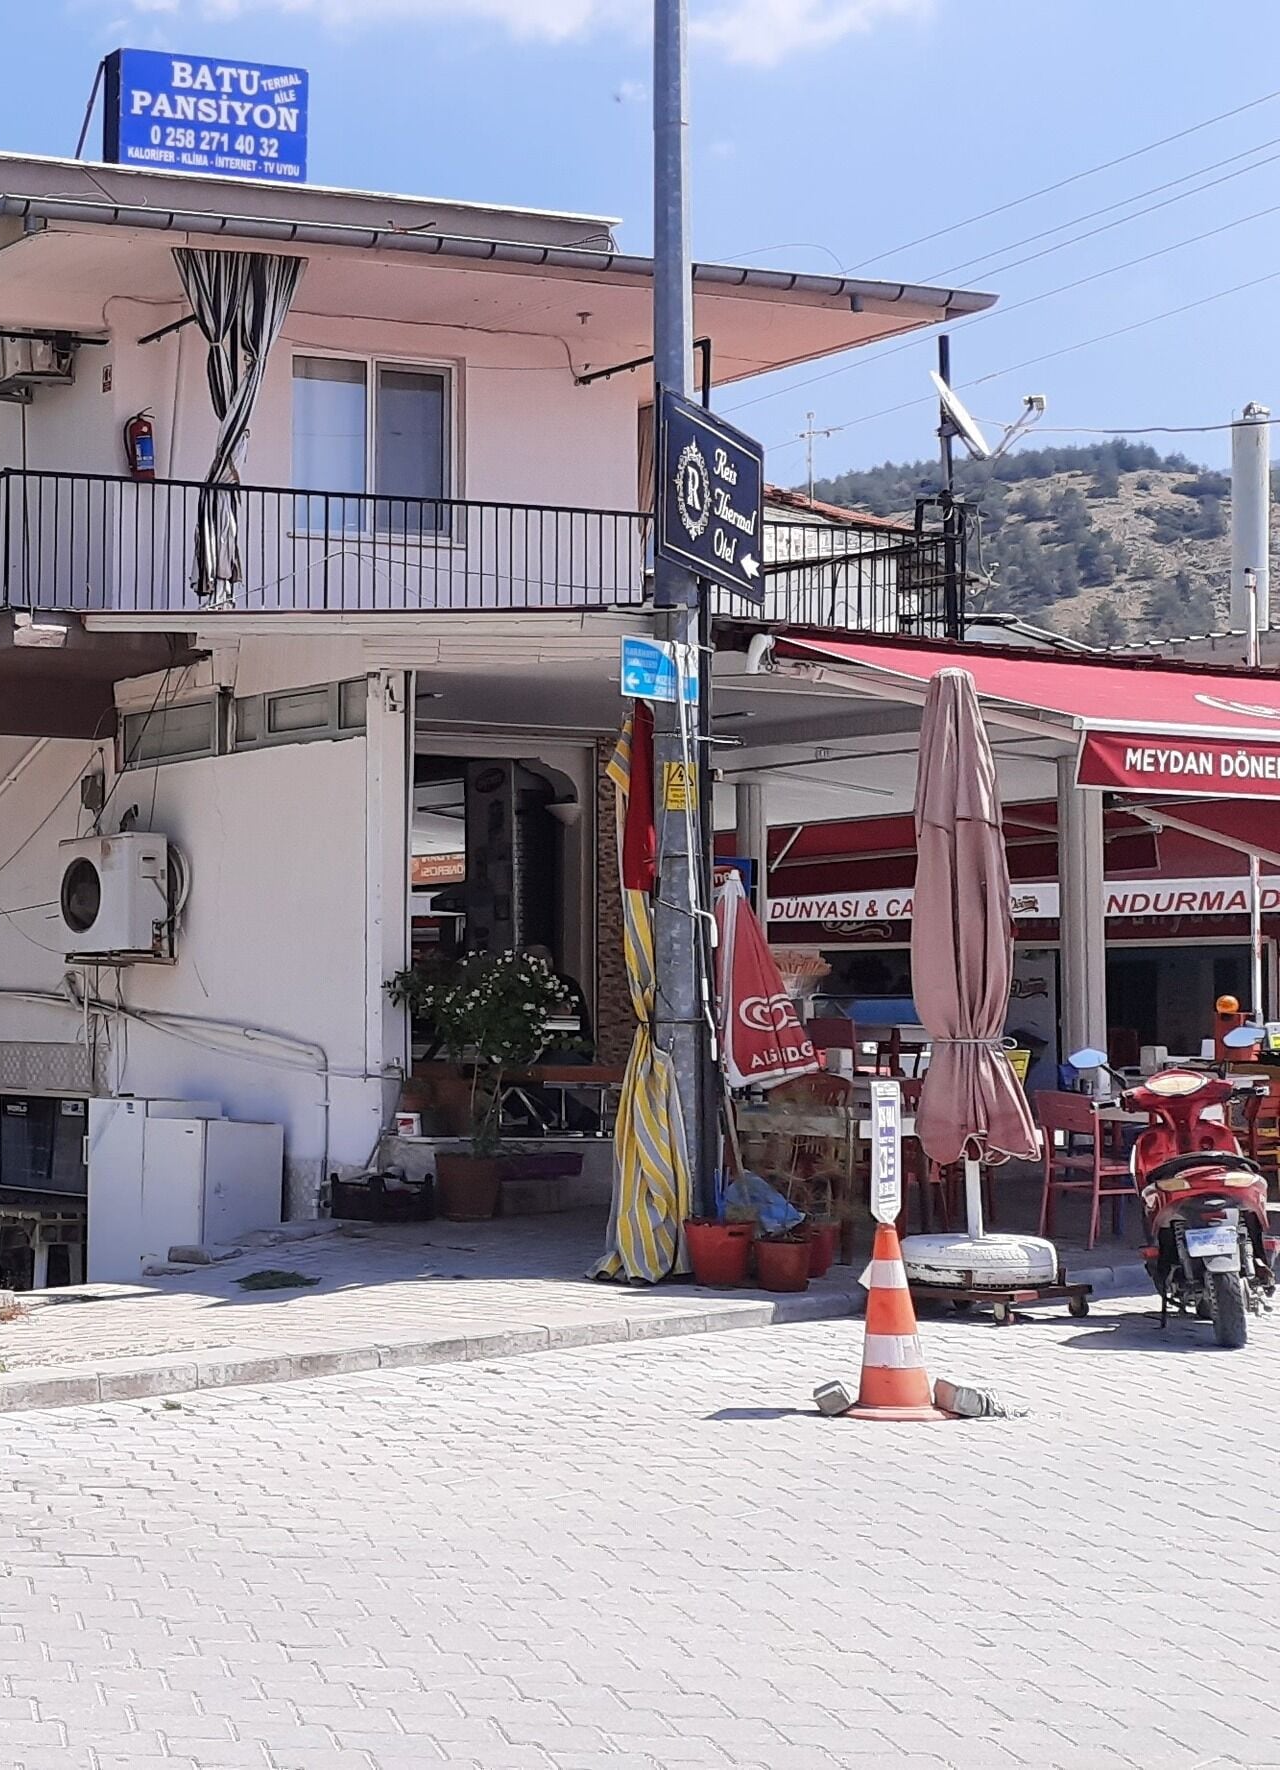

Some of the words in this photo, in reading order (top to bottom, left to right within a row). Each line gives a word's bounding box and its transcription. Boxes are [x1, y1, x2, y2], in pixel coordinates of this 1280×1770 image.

[171, 61, 261, 96] BATU
[260, 73, 302, 92] TERMAL
[130, 90, 300, 132] PANSİYON
[274, 89, 297, 105] AİLE
[150, 125, 162, 145] 0
[165, 126, 196, 149] 258
[200, 130, 229, 152] 271
[234, 134, 255, 155] 40
[259, 136, 279, 158] 32
[127, 146, 176, 163] KALORİFER
[181, 151, 209, 167] KLİMA
[215, 153, 258, 172] İNTERNET
[264, 161, 276, 174] TV
[276, 163, 300, 177] UYDU
[713, 447, 738, 486] Reis
[713, 487, 758, 536] Thermal
[713, 528, 738, 564] Otel
[1124, 747, 1213, 775] MEYDAN
[770, 897, 860, 919] DÜNYASI
[865, 901, 879, 917] &
[886, 899, 914, 917] CA
[1106, 890, 1248, 913] NDURMA
